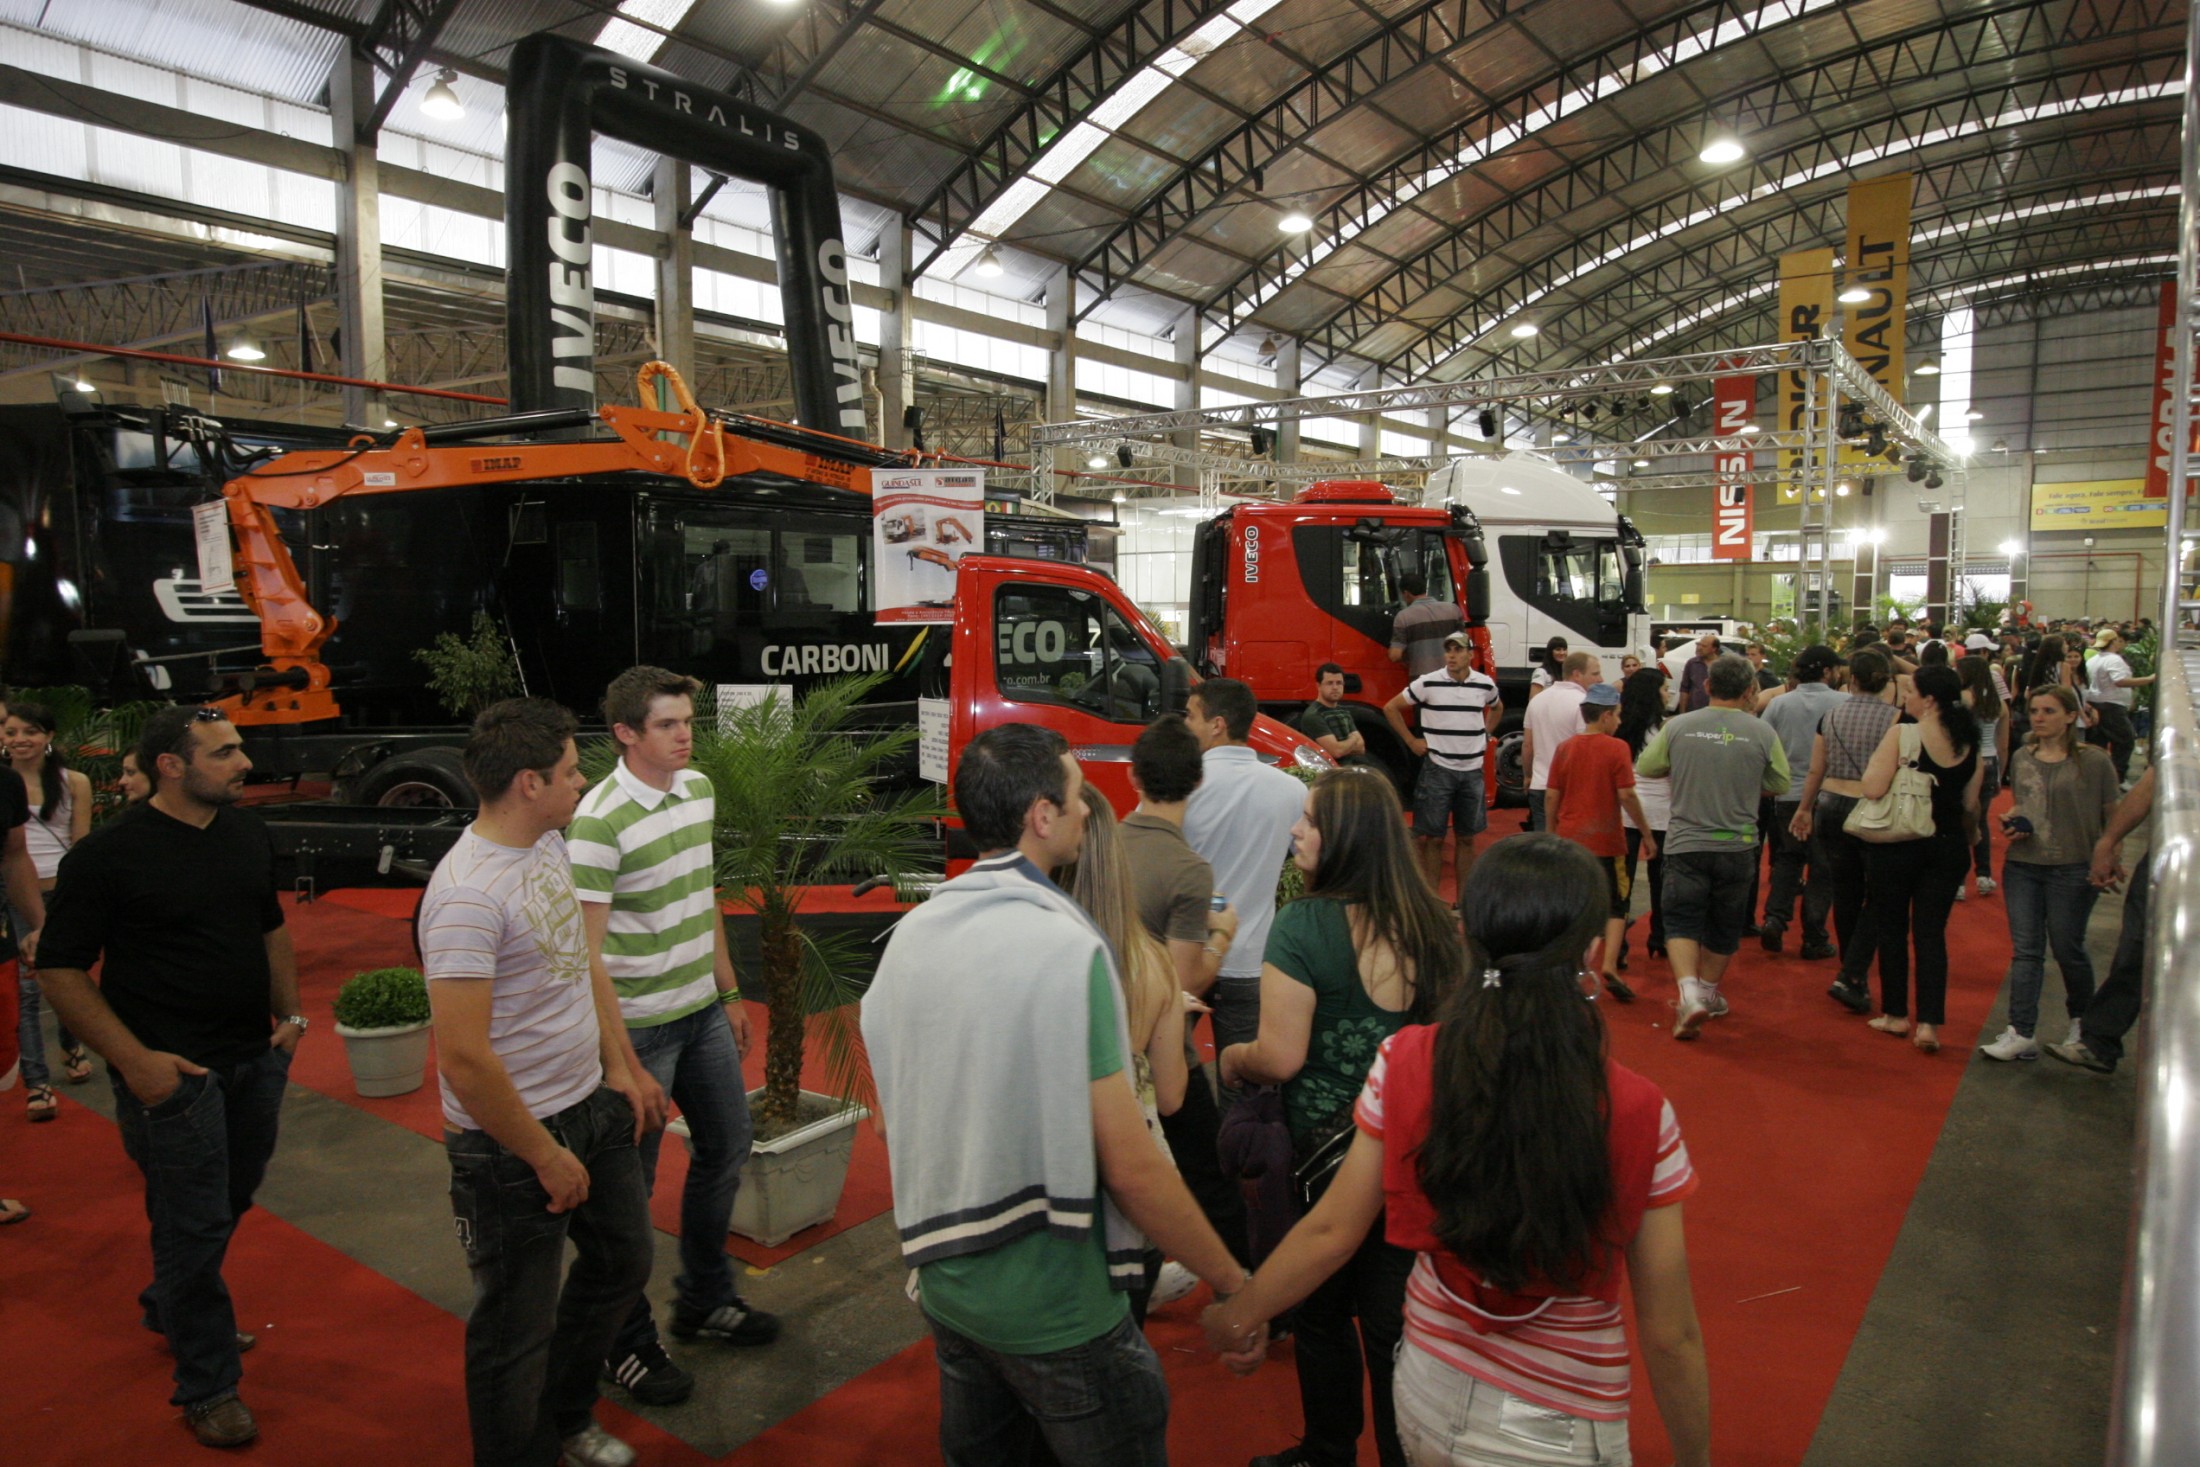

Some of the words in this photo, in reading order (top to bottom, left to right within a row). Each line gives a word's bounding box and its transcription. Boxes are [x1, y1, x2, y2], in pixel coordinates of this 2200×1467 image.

[610, 66, 799, 150] STRALIS
[547, 161, 595, 394] IVECO
[818, 238, 867, 428] IVECO
[1851, 233, 1895, 456] NAULT
[1718, 399, 1747, 546] NISSAN
[1245, 525, 1259, 583] IVECO
[760, 643, 890, 676] CARBONI
[998, 620, 1066, 665] ECO
[1003, 671, 1051, 686] o.com.br
